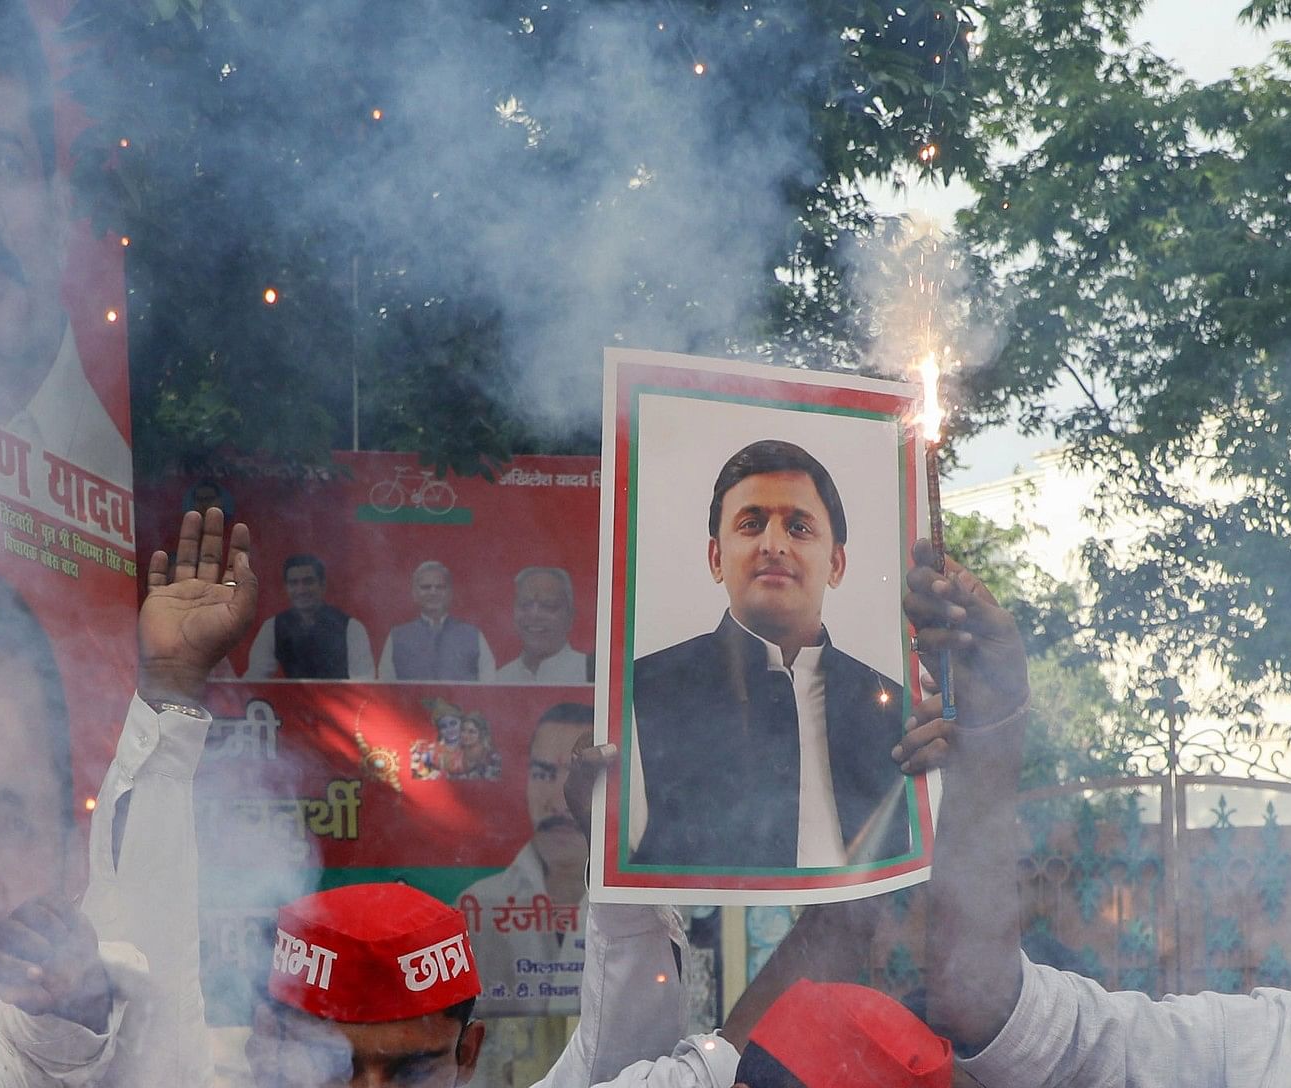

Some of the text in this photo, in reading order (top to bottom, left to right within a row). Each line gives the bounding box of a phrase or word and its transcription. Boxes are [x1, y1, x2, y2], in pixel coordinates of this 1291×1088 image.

[43, 450, 134, 544] यादव
[492, 894, 580, 933] रंजीत
[273, 927, 338, 991] सभा
[398, 932, 471, 992] छात्र
